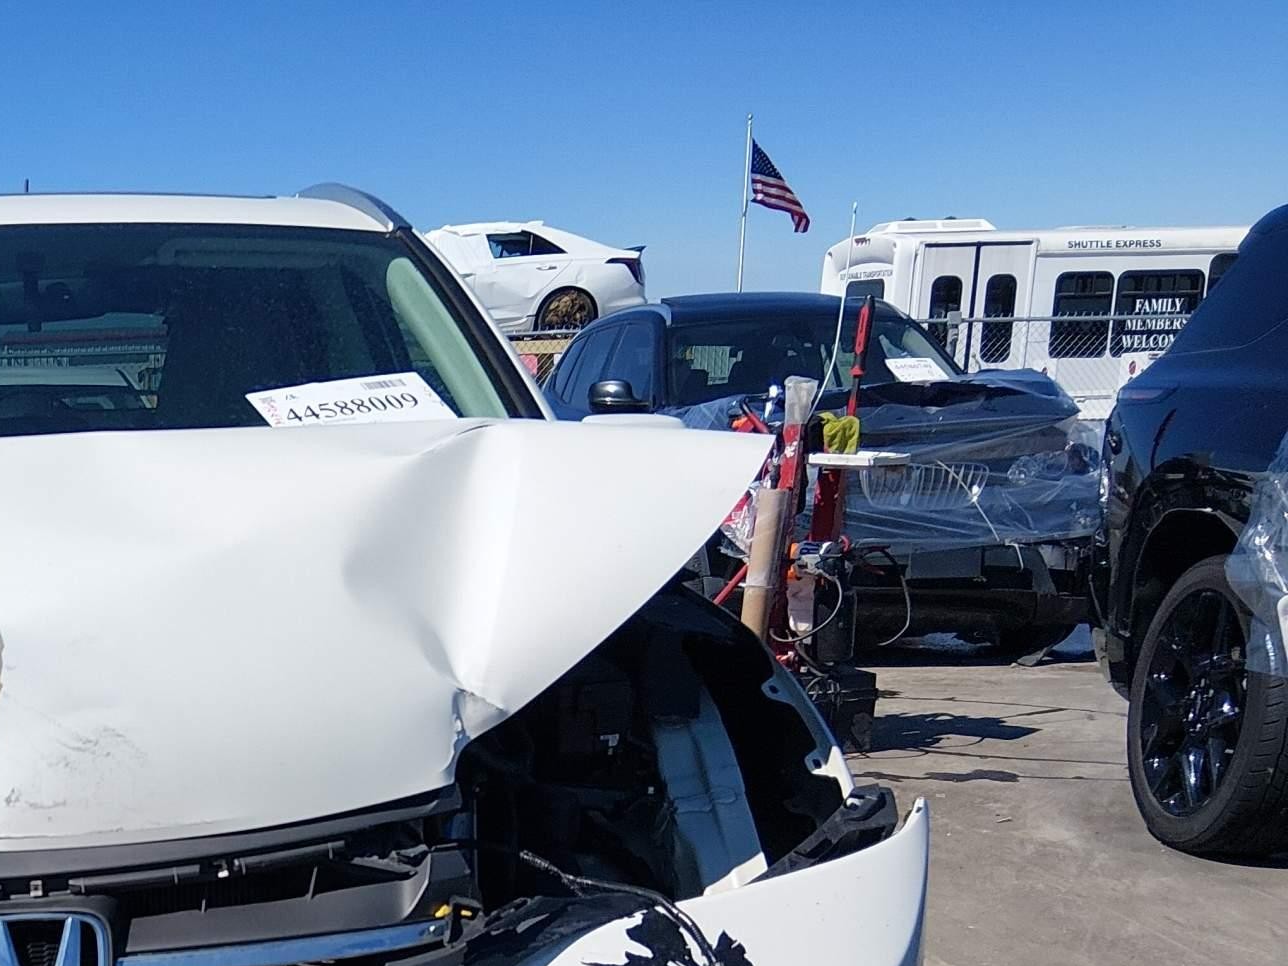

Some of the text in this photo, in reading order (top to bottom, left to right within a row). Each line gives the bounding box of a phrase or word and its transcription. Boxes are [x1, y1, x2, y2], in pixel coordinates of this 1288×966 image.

[1068, 239, 1162, 249] SHUTTLE EXPRESS
[1135, 298, 1184, 313] FAMILY
[287, 392, 418, 422] 44588009
